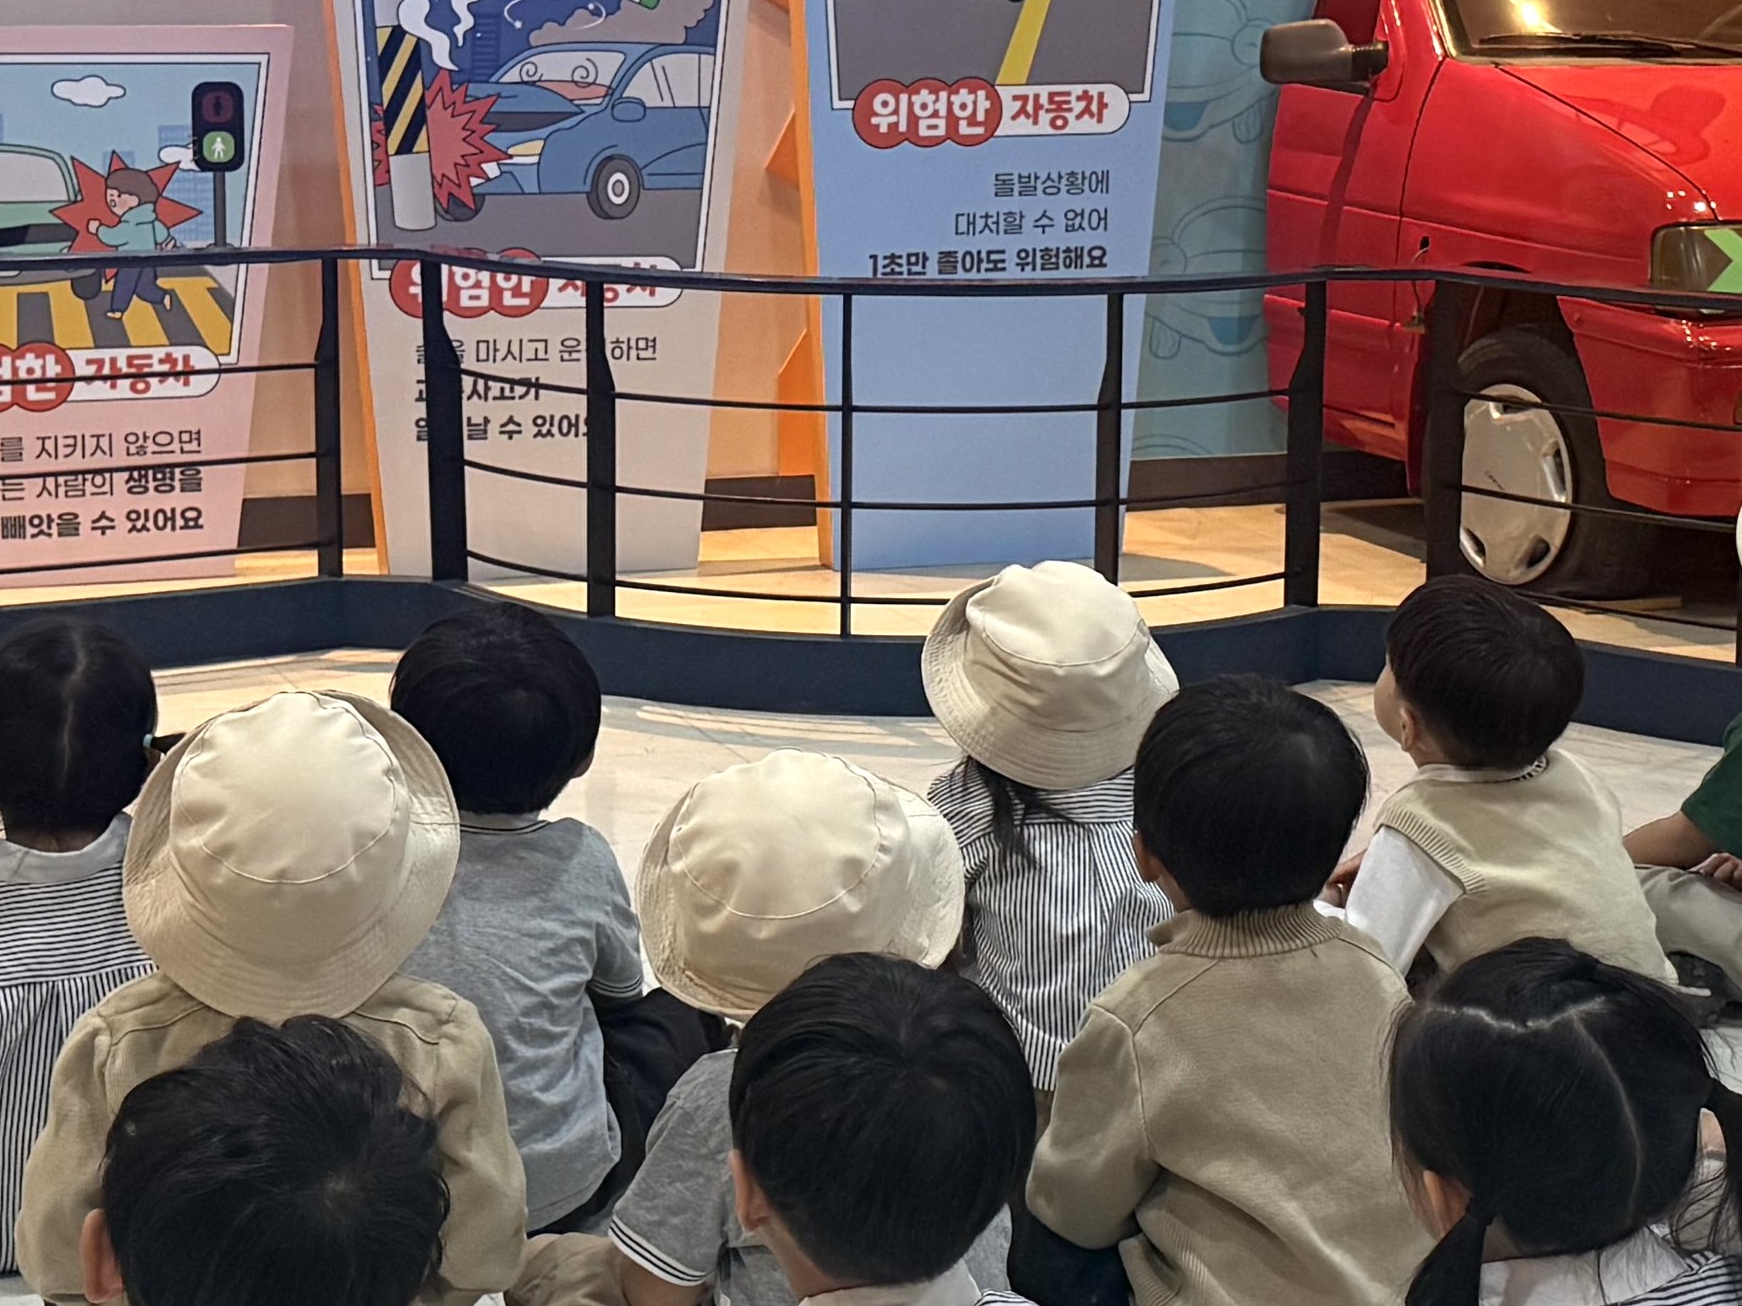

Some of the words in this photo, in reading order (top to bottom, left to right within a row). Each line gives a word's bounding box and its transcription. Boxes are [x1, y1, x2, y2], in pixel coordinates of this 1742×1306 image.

[870, 86, 990, 137] 위험한
[1010, 91, 1108, 131] 자동차
[993, 169, 1110, 197] 돌발상황에
[954, 210, 1025, 238] 대처할
[1032, 210, 1056, 236] 수
[1063, 207, 1109, 234] 없어
[868, 250, 928, 279] 1초만
[936, 248, 1007, 276] 졸아도
[1014, 245, 1108, 273] 위험해요
[476, 337, 549, 364] 마시고
[559, 336, 657, 363] 운하면
[85, 352, 195, 394] 자동차
[498, 416, 523, 439] 수
[532, 414, 589, 441] 있어
[35, 433, 113, 460] 지키지
[124, 429, 202, 457] 않으면
[124, 467, 203, 495] 생명을
[1, 512, 81, 540] 빼앗을
[91, 510, 116, 536] 수
[126, 506, 204, 534] 있어요
